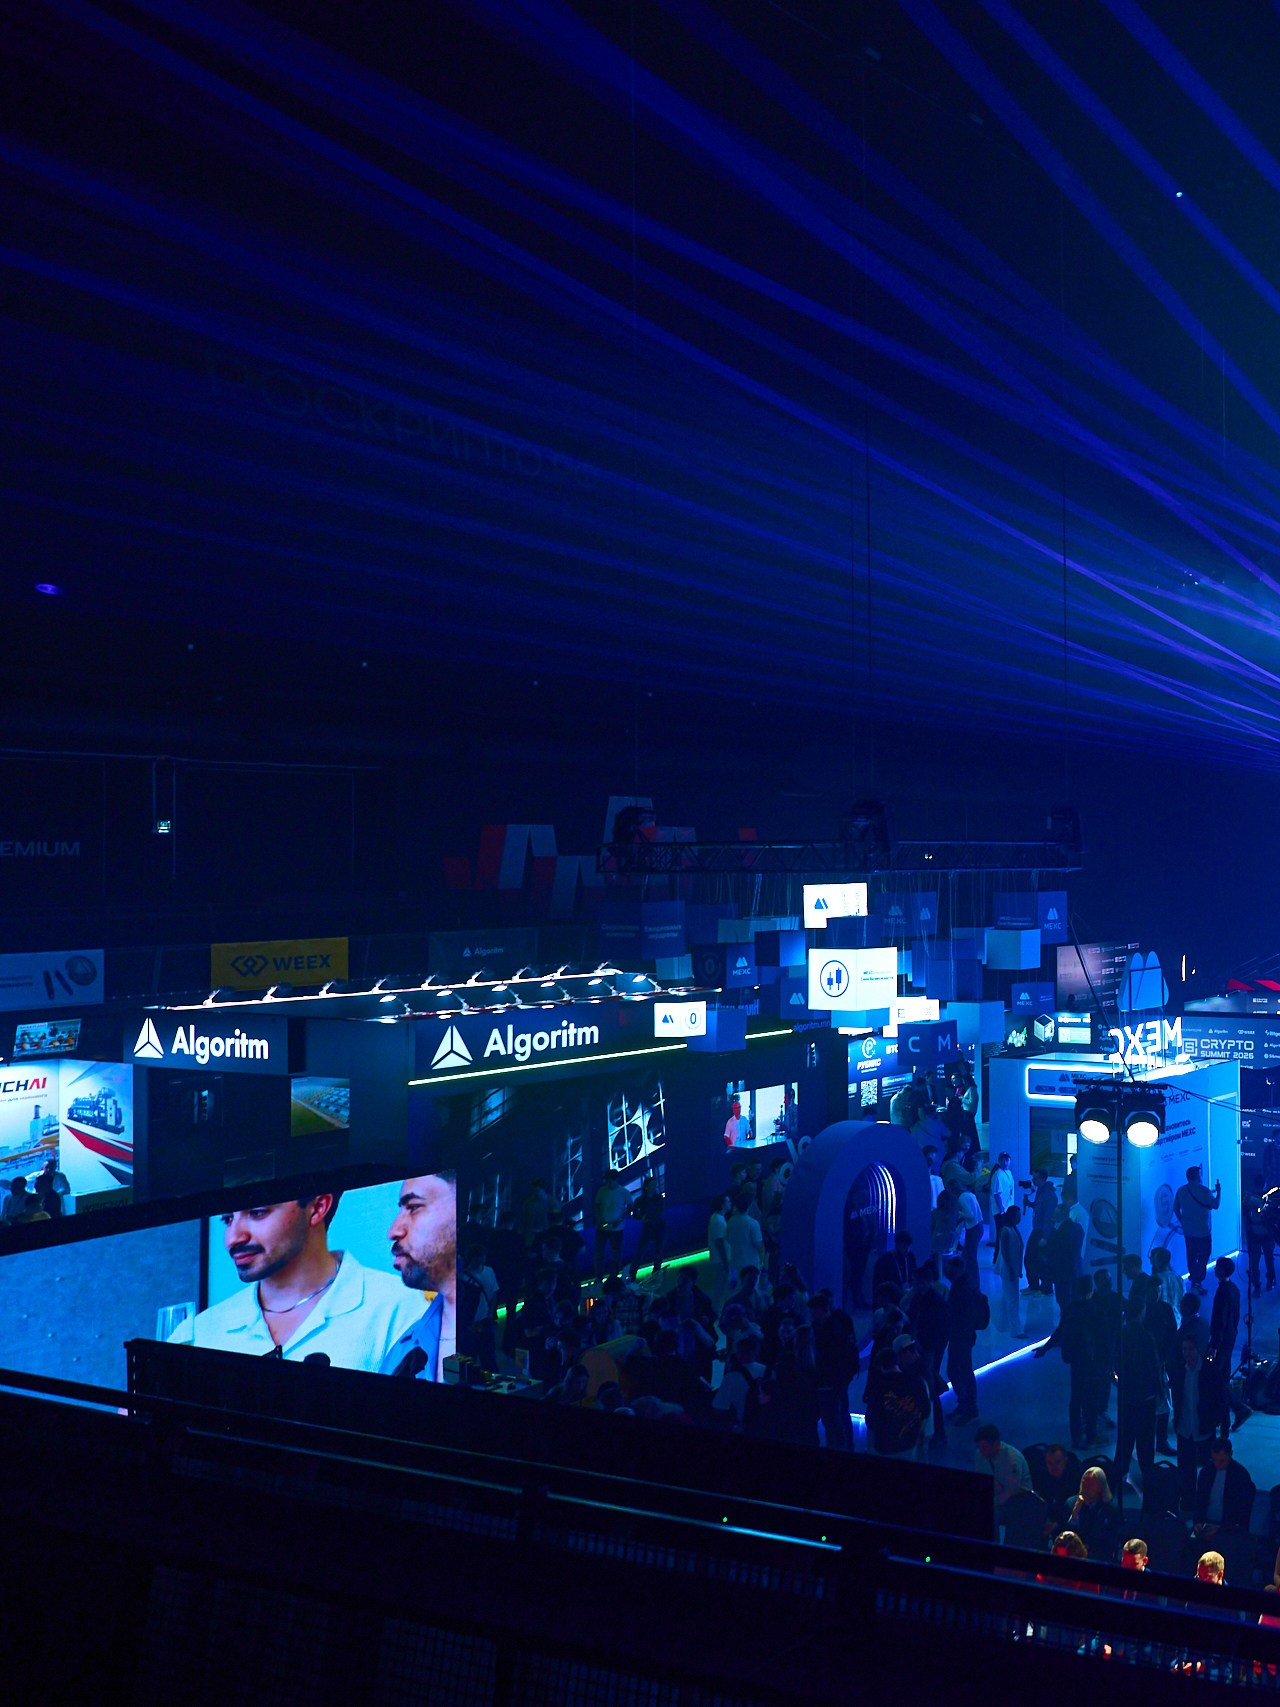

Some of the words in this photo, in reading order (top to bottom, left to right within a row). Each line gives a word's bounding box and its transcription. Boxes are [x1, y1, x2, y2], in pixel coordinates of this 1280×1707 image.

[474, 947, 504, 957] Algoritm
[272, 954, 331, 971] WEEX
[171, 1025, 269, 1065] Algoritm
[483, 1020, 600, 1062] Algoritm
[908, 1036, 920, 1052] C
[938, 1034, 951, 1051] M
[1200, 1039, 1254, 1051] CRYPTO
[1200, 1051, 1230, 1059] SUMMIT
[1168, 1093, 1191, 1105] MEXC
[1181, 1127, 1196, 1138] MEXC
[859, 1205, 880, 1216] MEX
